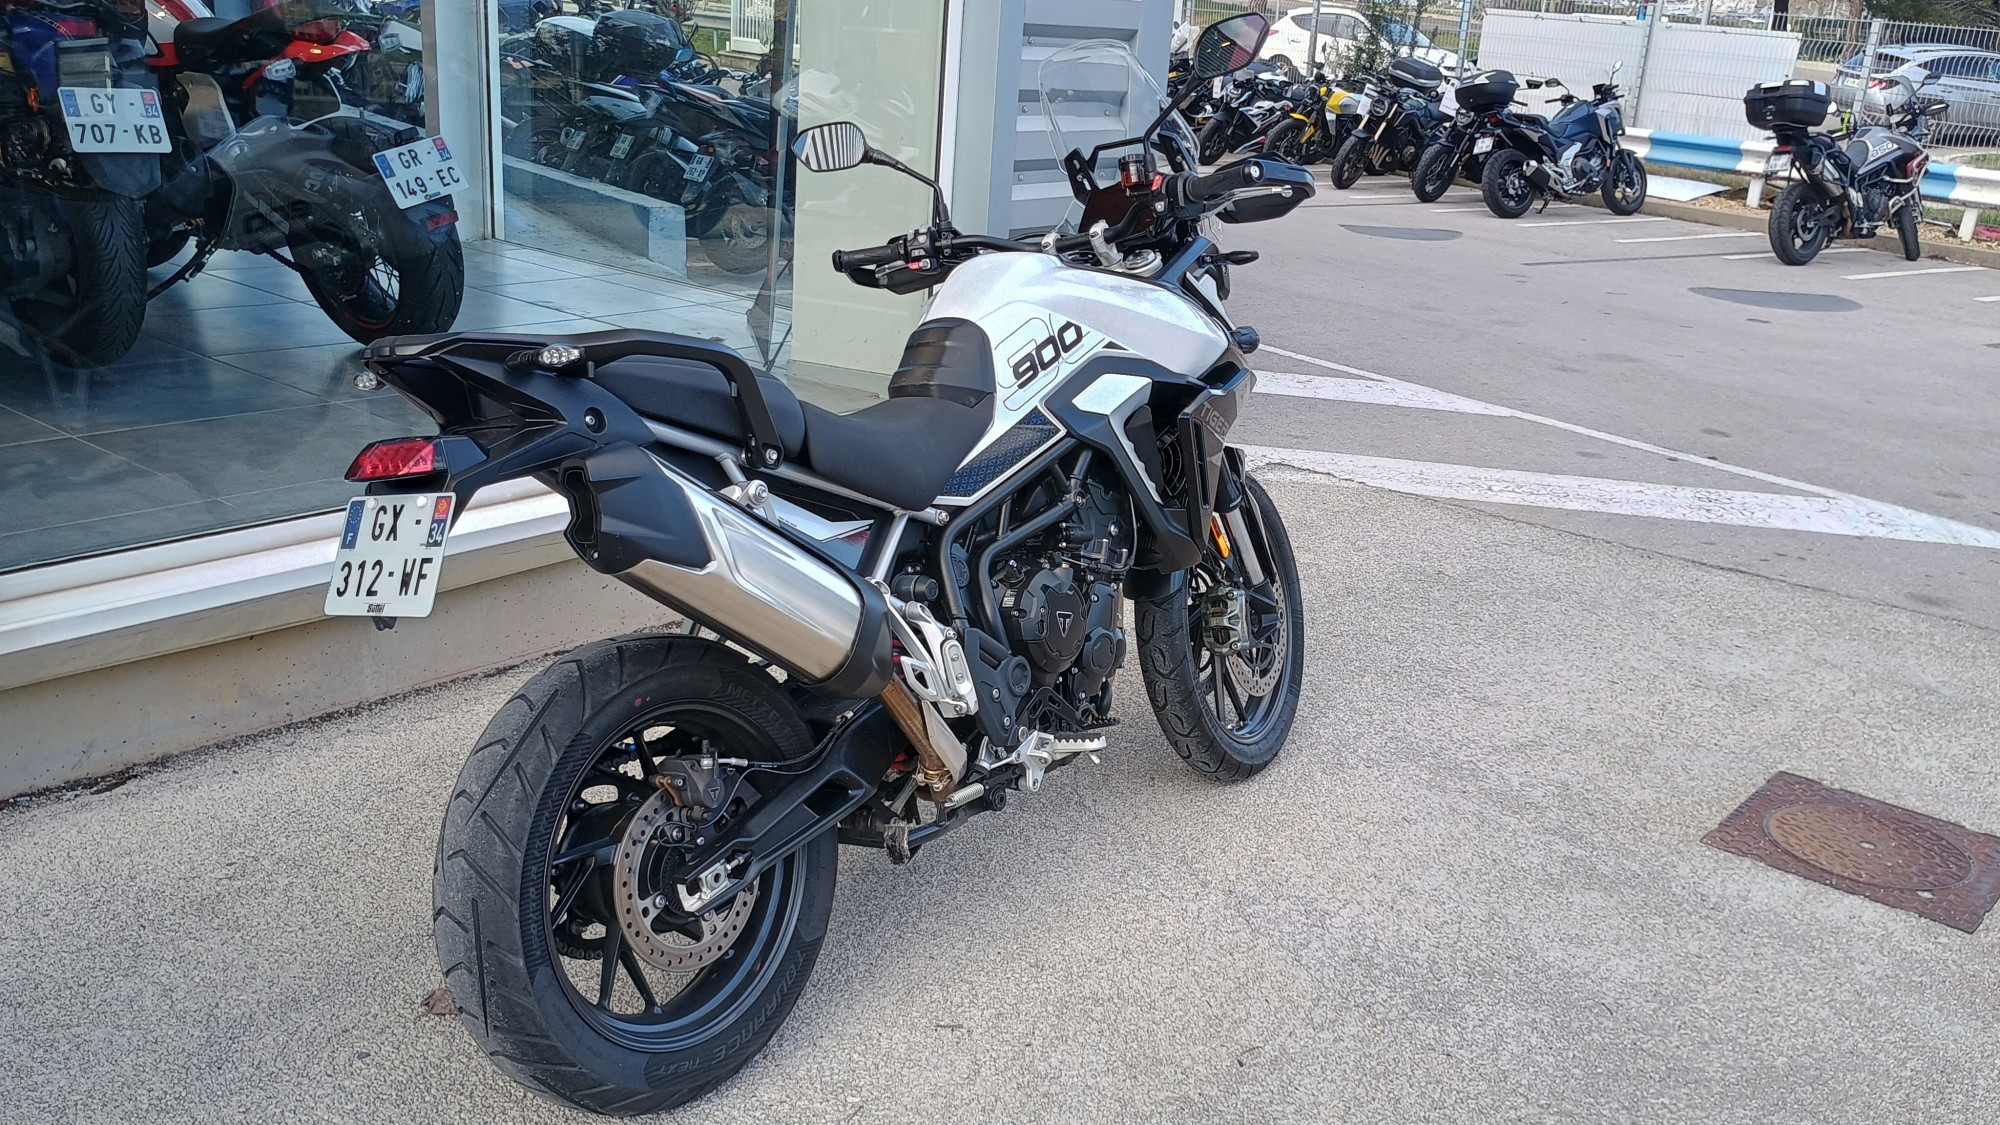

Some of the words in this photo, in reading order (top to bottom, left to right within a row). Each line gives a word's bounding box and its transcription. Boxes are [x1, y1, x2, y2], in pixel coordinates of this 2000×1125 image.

[90, 93, 117, 114] GY
[145, 105, 158, 116] 34
[397, 149, 423, 169] GR
[439, 151, 451, 160] 34
[1012, 320, 1083, 389] 900
[1200, 401, 1230, 438] TIGER
[371, 504, 405, 541] GX
[428, 522, 445, 544] 34
[346, 532, 354, 544] F
[336, 557, 434, 597] 312-WF
[711, 950, 807, 1064] TOURANCE
